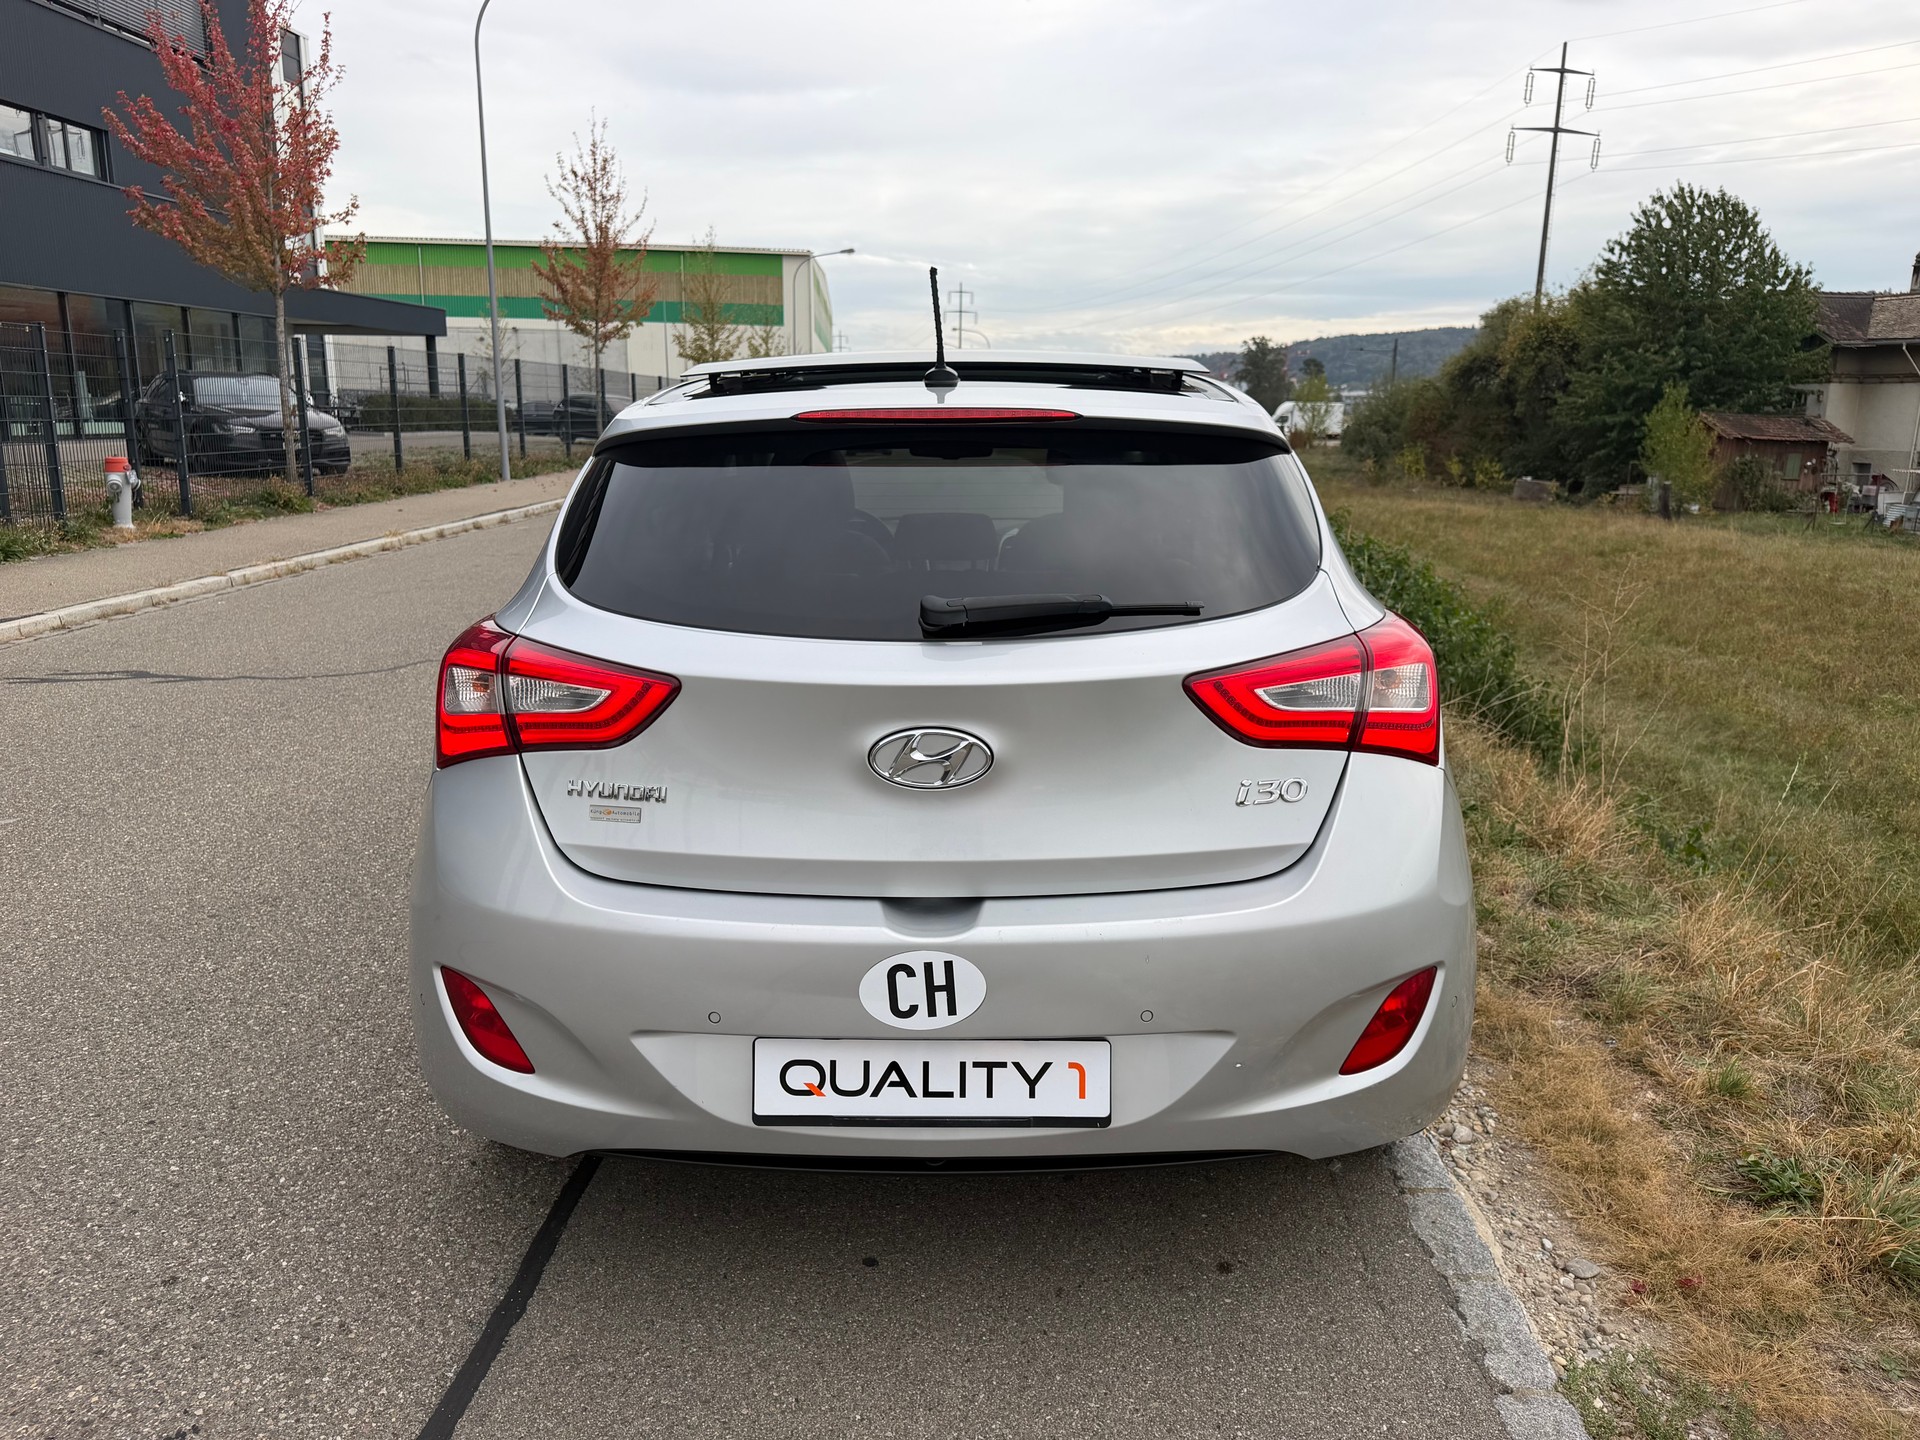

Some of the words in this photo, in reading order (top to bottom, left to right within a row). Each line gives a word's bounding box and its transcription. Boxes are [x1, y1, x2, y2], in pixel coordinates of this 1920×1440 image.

[567, 780, 667, 803] HYUNDAI
[1236, 778, 1308, 807] i30
[886, 960, 957, 1019] CH
[779, 1059, 1053, 1099] QUALITY
[1067, 1061, 1086, 1100] 1
